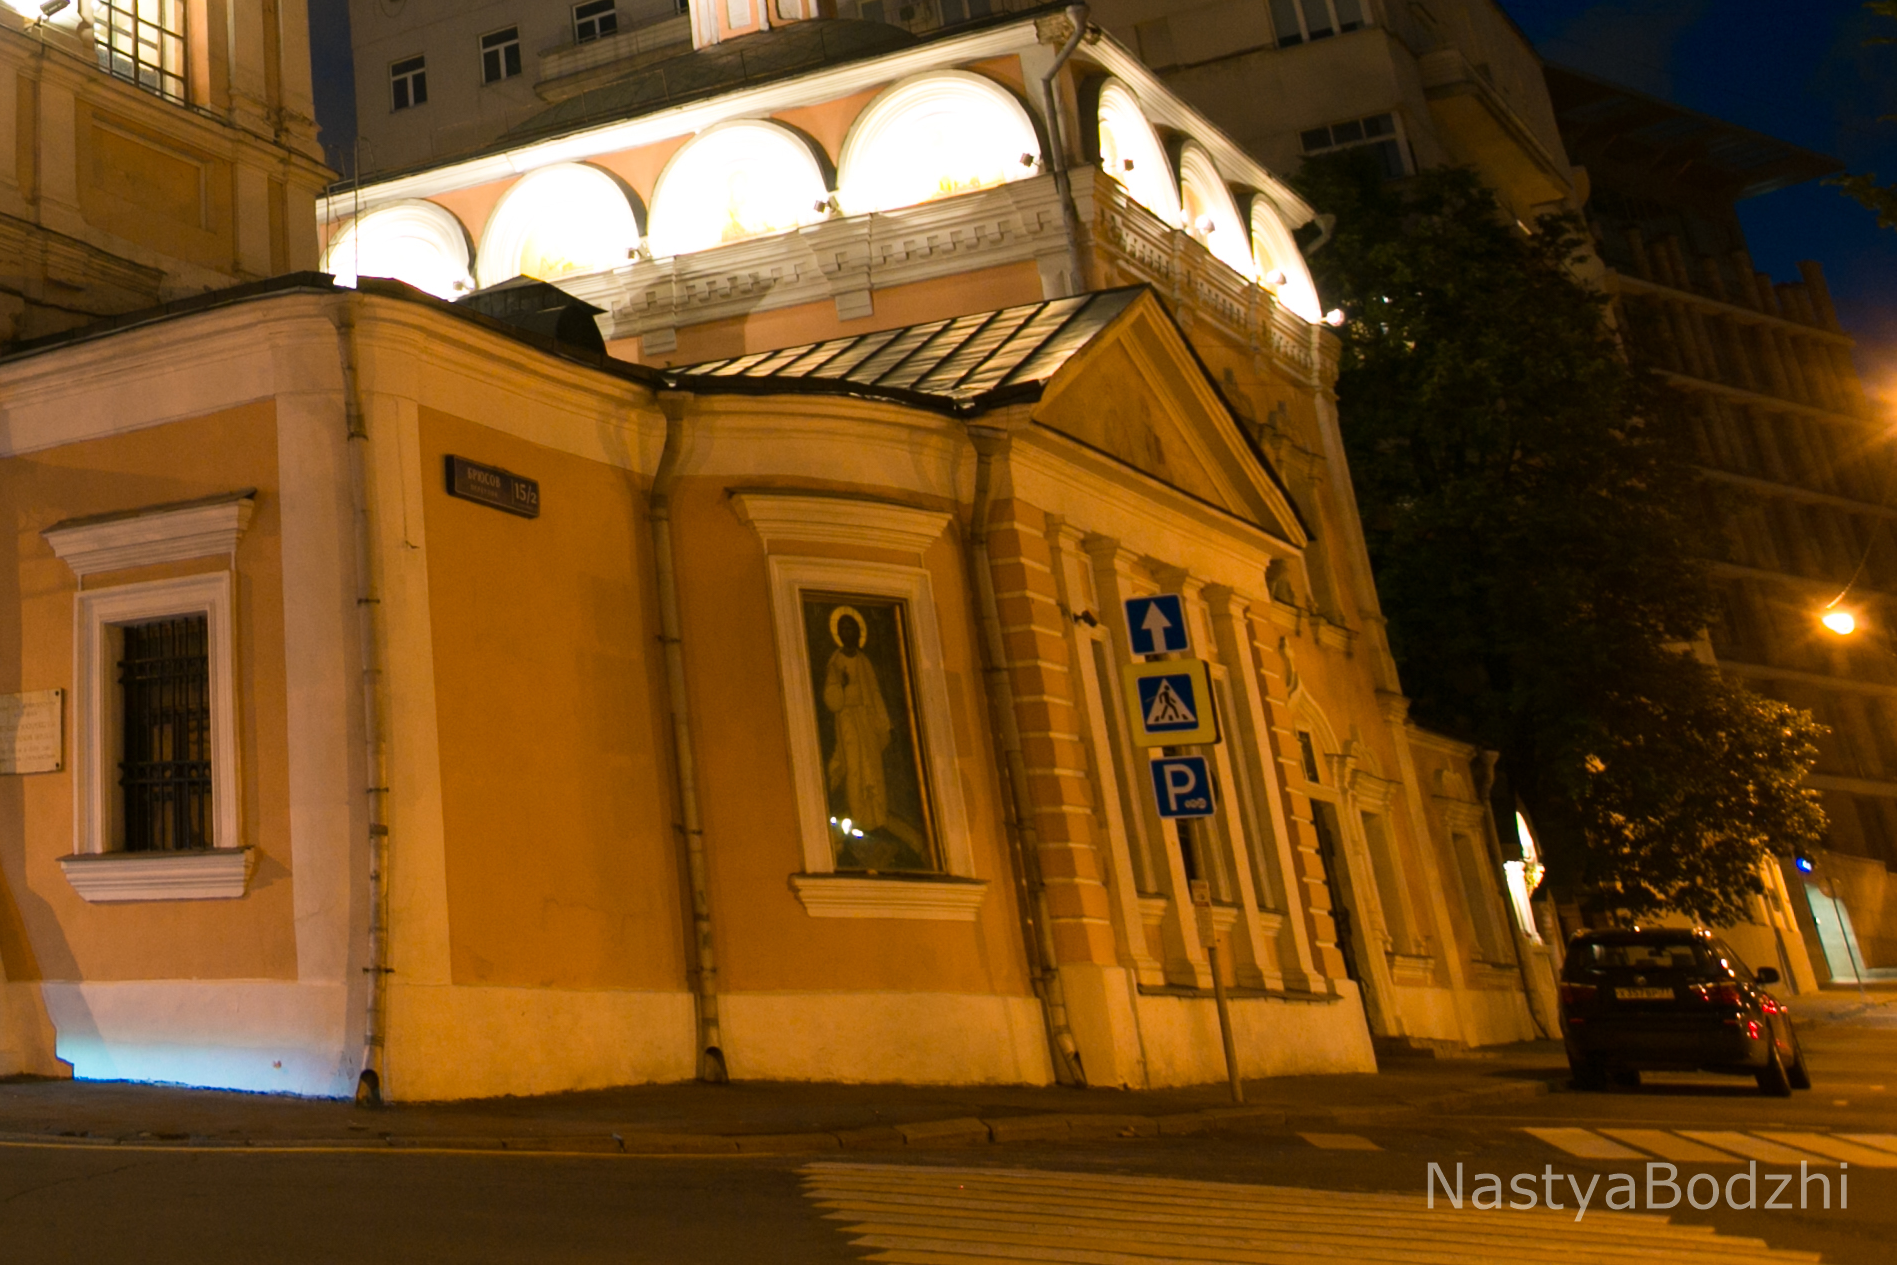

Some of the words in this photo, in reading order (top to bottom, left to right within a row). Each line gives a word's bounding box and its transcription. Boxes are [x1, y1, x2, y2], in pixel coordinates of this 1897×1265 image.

[468, 467, 501, 488] БРЮСОВ
[514, 482, 537, 504] 15/2
[1163, 763, 1197, 812] P
